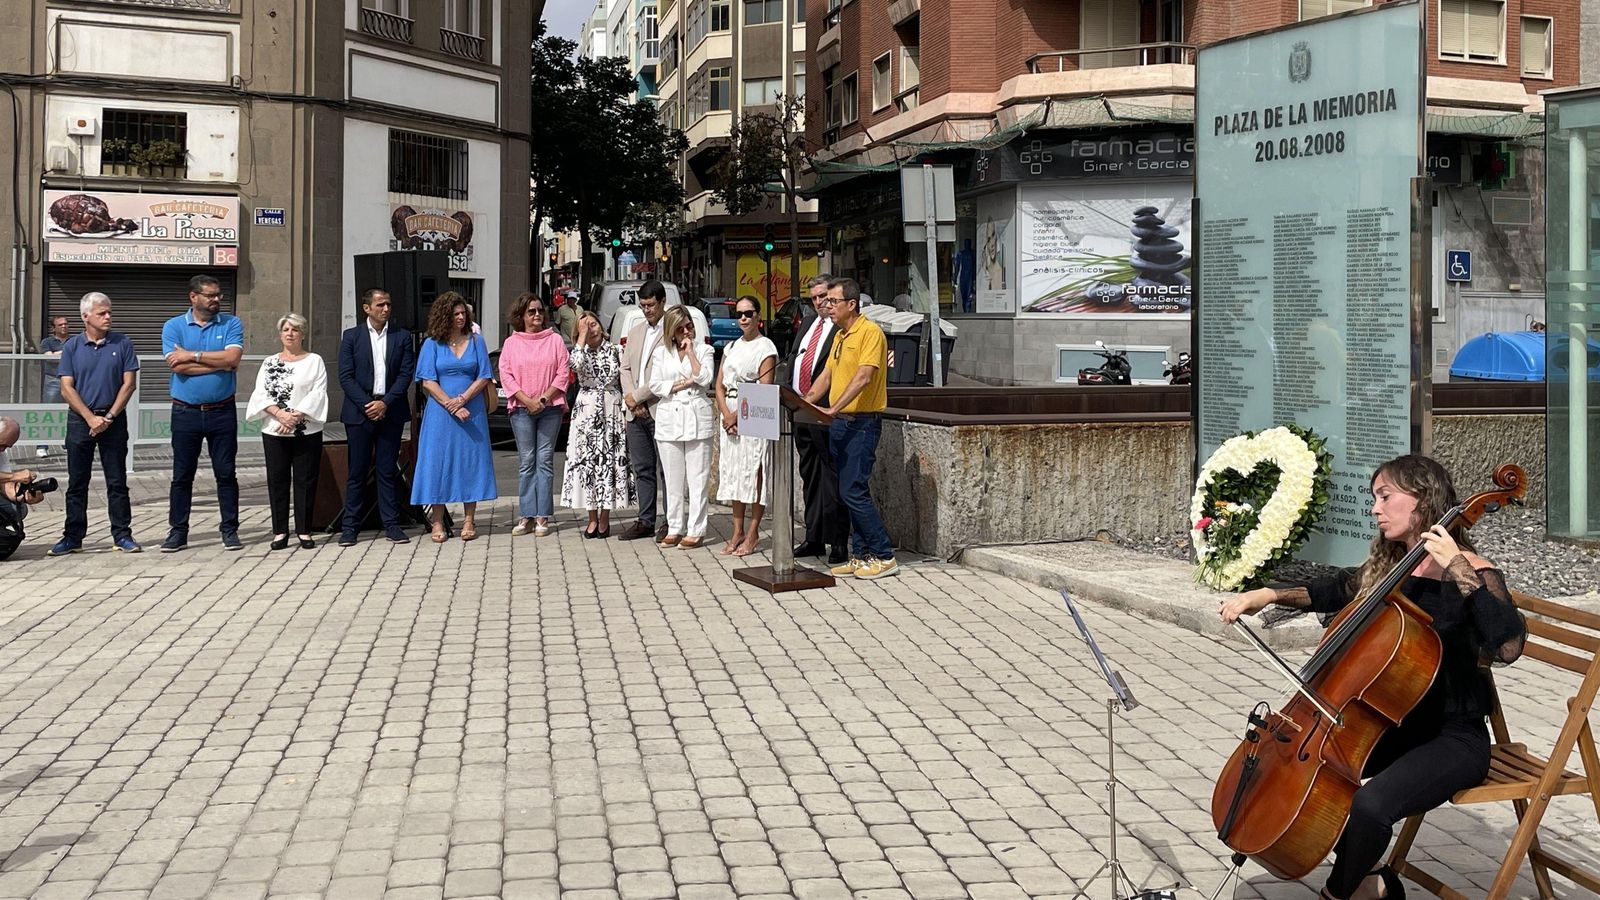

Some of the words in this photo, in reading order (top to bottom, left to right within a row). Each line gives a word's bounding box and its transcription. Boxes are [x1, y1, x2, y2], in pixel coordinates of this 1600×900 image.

[1214, 110, 1259, 136] PLAZA
[1264, 106, 1283, 130] DE
[1288, 102, 1308, 126] LA
[1313, 88, 1397, 122] MEMORIA
[1070, 138, 1195, 158] farmacia
[1255, 131, 1345, 162] 20.08.2008
[1084, 160, 1124, 172] Giner
[1428, 156, 1450, 168] rio
[176, 204, 224, 216] CAFETERIA
[142, 218, 168, 238] La
[175, 218, 236, 239] Prensa
[410, 218, 422, 230] BAR
[424, 216, 458, 233] CAFETERIA
[144, 246, 171, 255] DEL
[216, 250, 236, 264] Bc
[740, 272, 753, 286] La
[1122, 284, 1191, 294] farmacia
[1358, 485, 1371, 494] Gra
